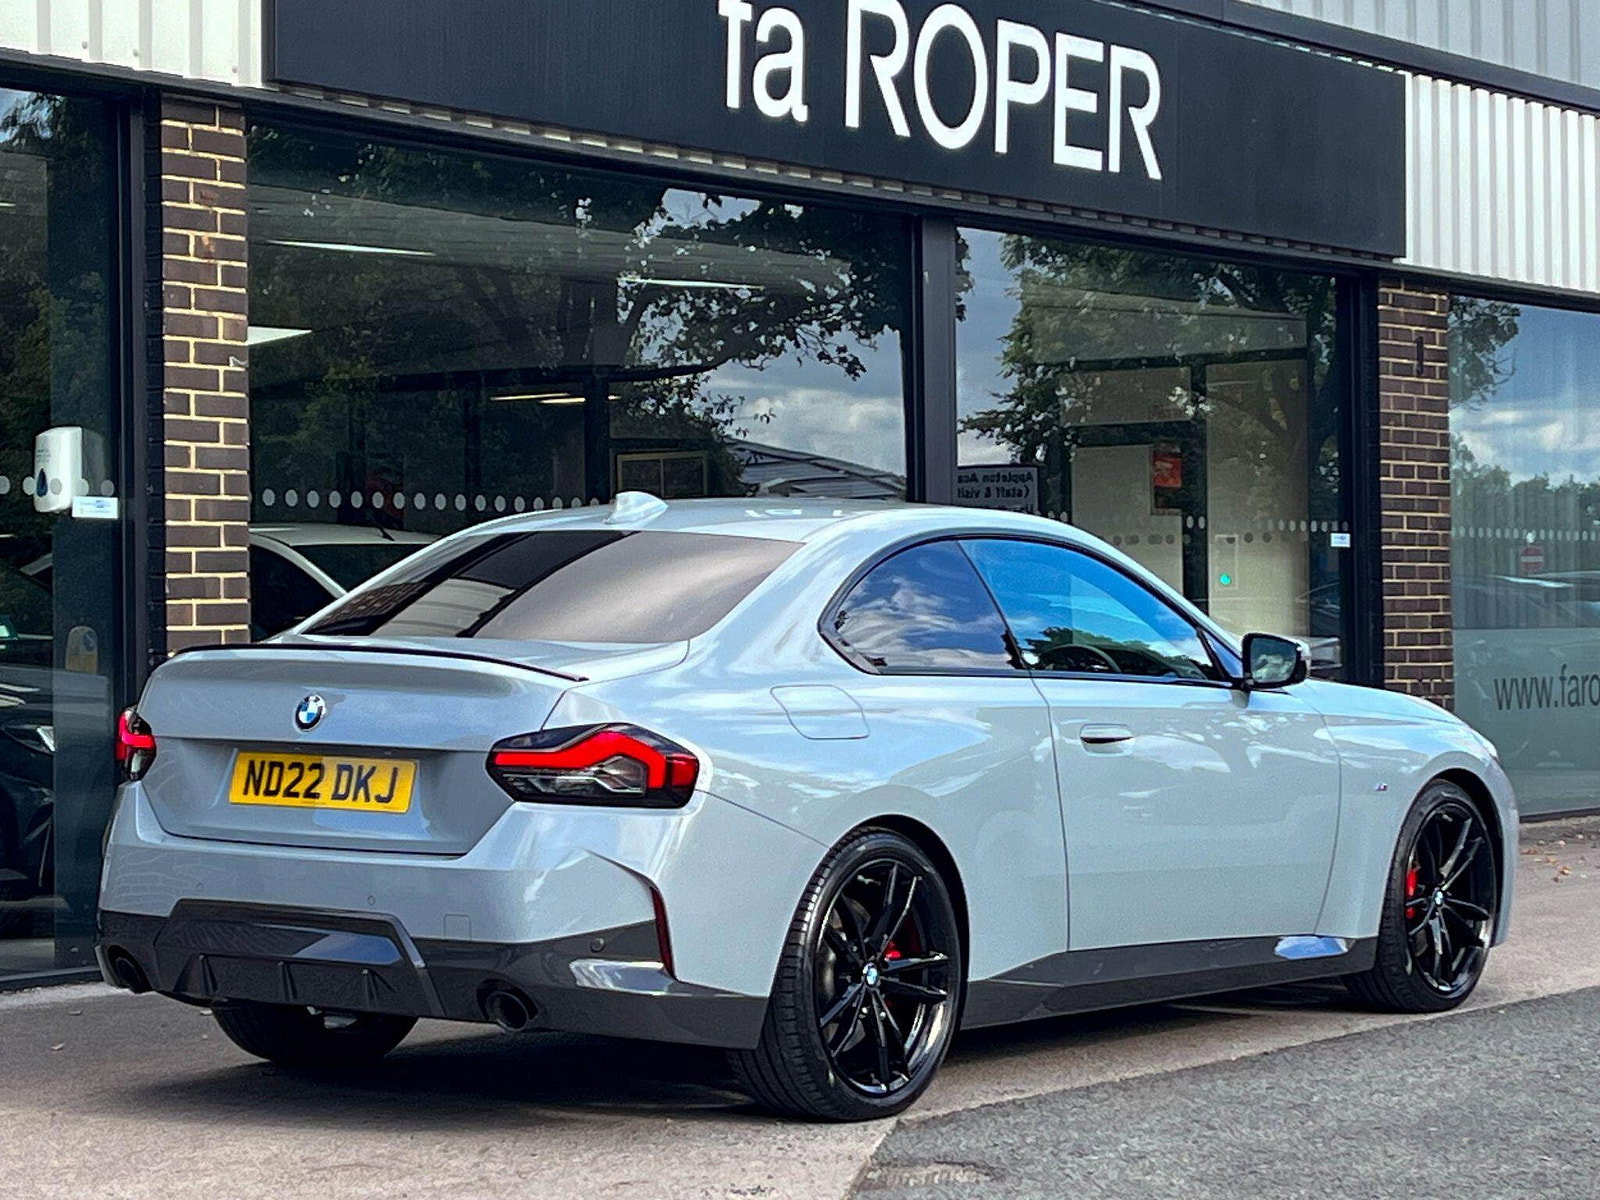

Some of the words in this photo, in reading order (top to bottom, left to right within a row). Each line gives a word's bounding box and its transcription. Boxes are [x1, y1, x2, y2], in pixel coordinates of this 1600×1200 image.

[718, 0, 809, 122] fa
[845, 0, 1163, 181] ROPER
[1493, 663, 1600, 711] www.faro
[242, 759, 326, 800] ND22
[330, 763, 399, 804] DKJ
